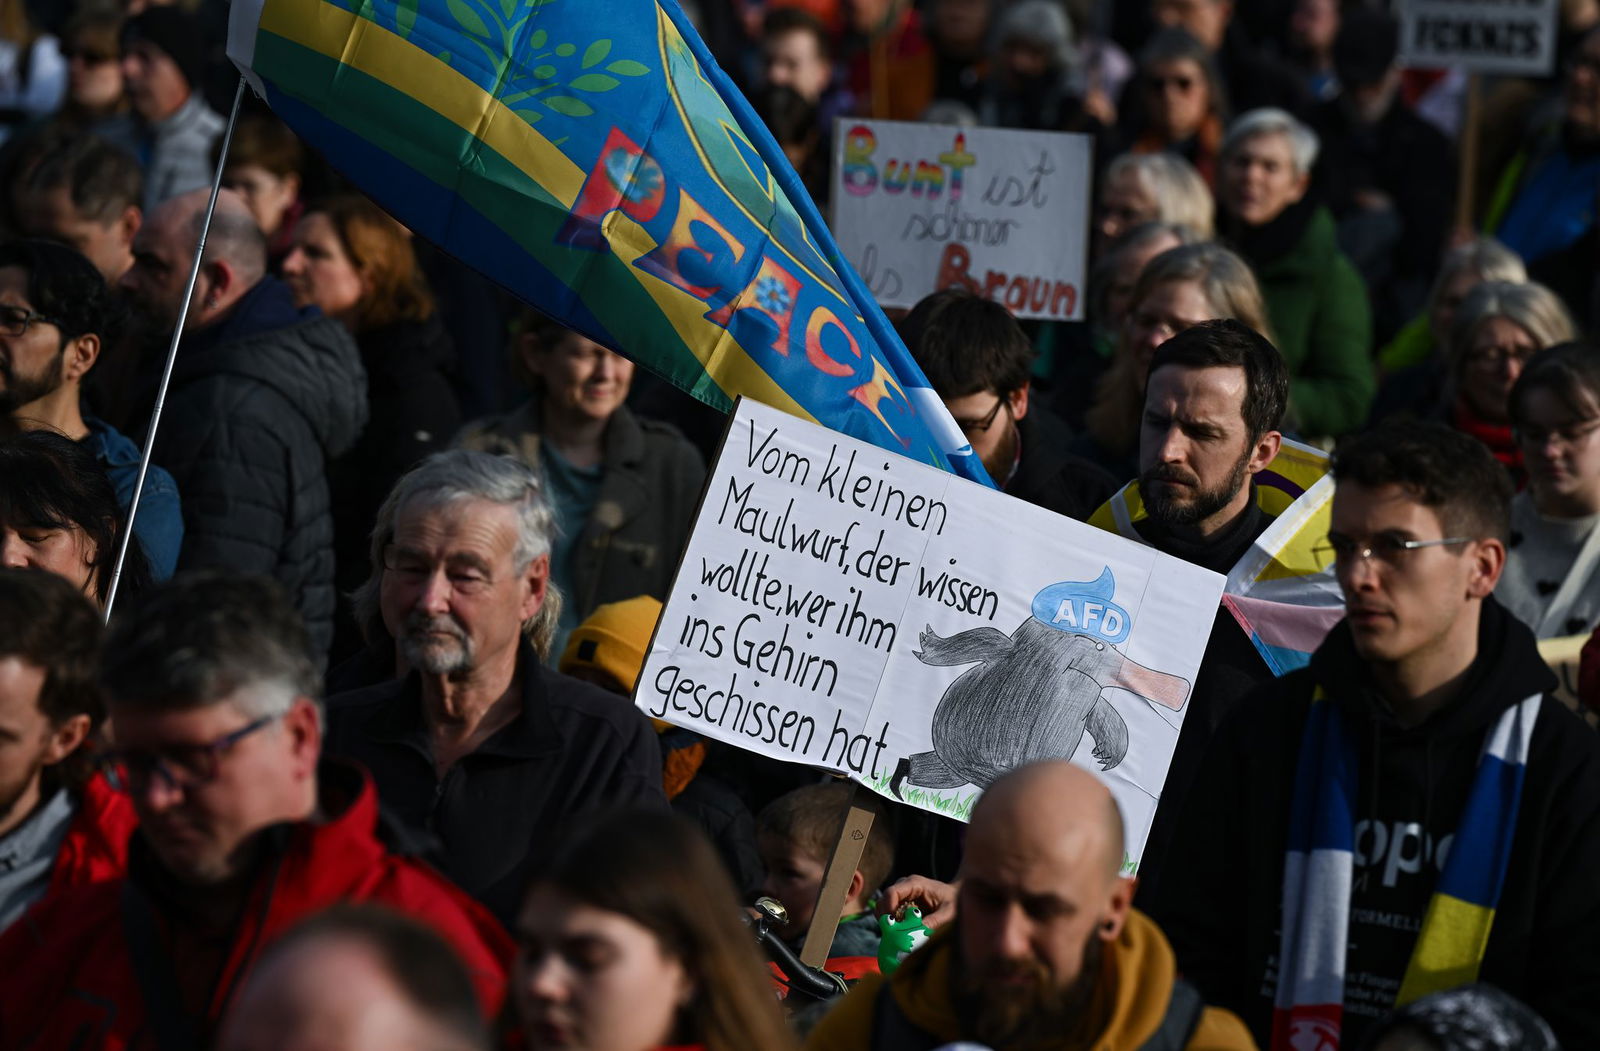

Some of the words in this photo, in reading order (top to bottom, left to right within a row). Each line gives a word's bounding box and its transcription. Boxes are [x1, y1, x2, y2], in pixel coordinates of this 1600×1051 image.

[843, 125, 975, 199] Bunt
[983, 151, 1055, 208] ist
[554, 125, 915, 450] PEACE
[858, 243, 903, 298] ls
[936, 243, 1077, 316] Braun
[748, 419, 810, 486] Vom
[817, 444, 947, 535] kleinen
[786, 584, 836, 627] wer
[836, 586, 896, 652] ihm
[855, 529, 910, 586] der
[918, 558, 998, 620] wissen
[1052, 599, 1124, 637] AFD
[680, 593, 726, 658] ins
[733, 613, 838, 697] Gehirn
[650, 666, 815, 755] geschissen
[822, 709, 890, 779] hat
